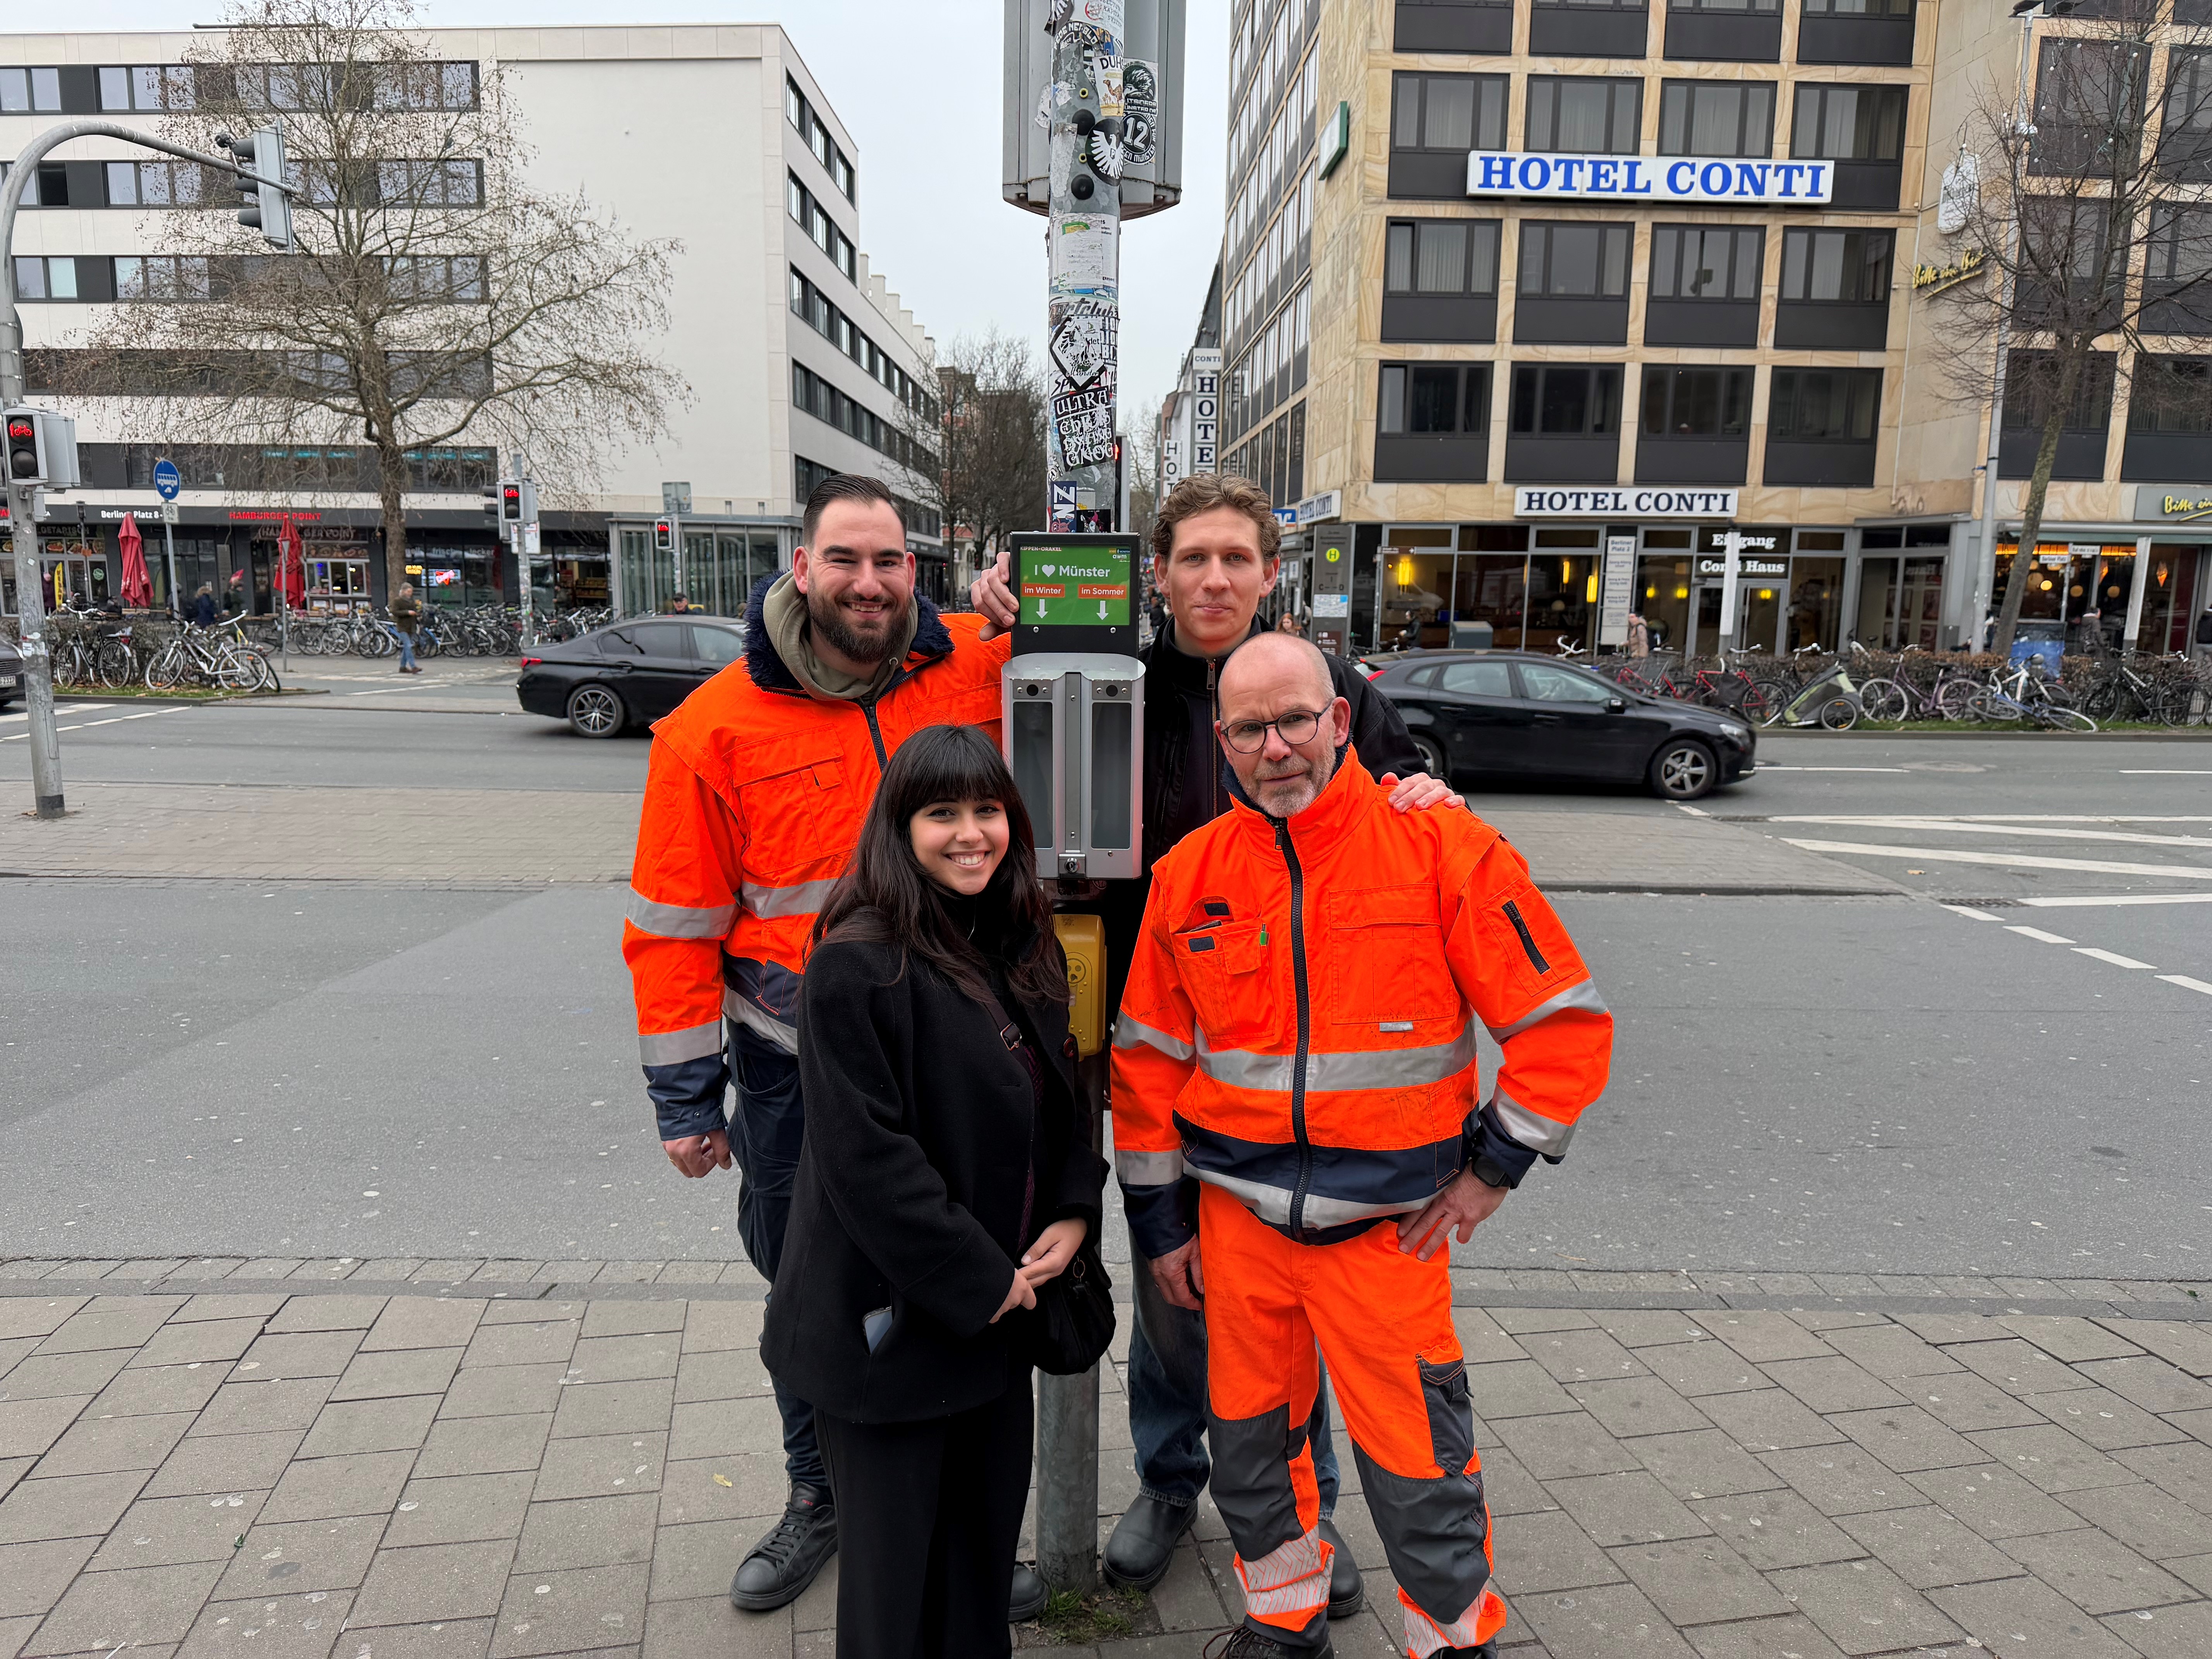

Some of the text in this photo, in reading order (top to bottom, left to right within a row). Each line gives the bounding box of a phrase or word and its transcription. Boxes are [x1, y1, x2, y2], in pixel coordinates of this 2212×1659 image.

[1124, 117, 1149, 150] 12
[1478, 156, 1824, 198] HOTEL CONTI
[1056, 389, 1108, 415] ULTRA
[1197, 376, 1216, 472] HOTE
[1524, 492, 1731, 512] HOTEL CONTI
[2165, 495, 2194, 514] Bitte
[101, 510, 127, 518] Berline
[229, 512, 289, 520] HAMBURGER
[1711, 534, 1776, 550] Eigang
[1329, 551, 1336, 559] H
[1059, 565, 1110, 577] Münster
[1700, 560, 1785, 573] Coni Haus
